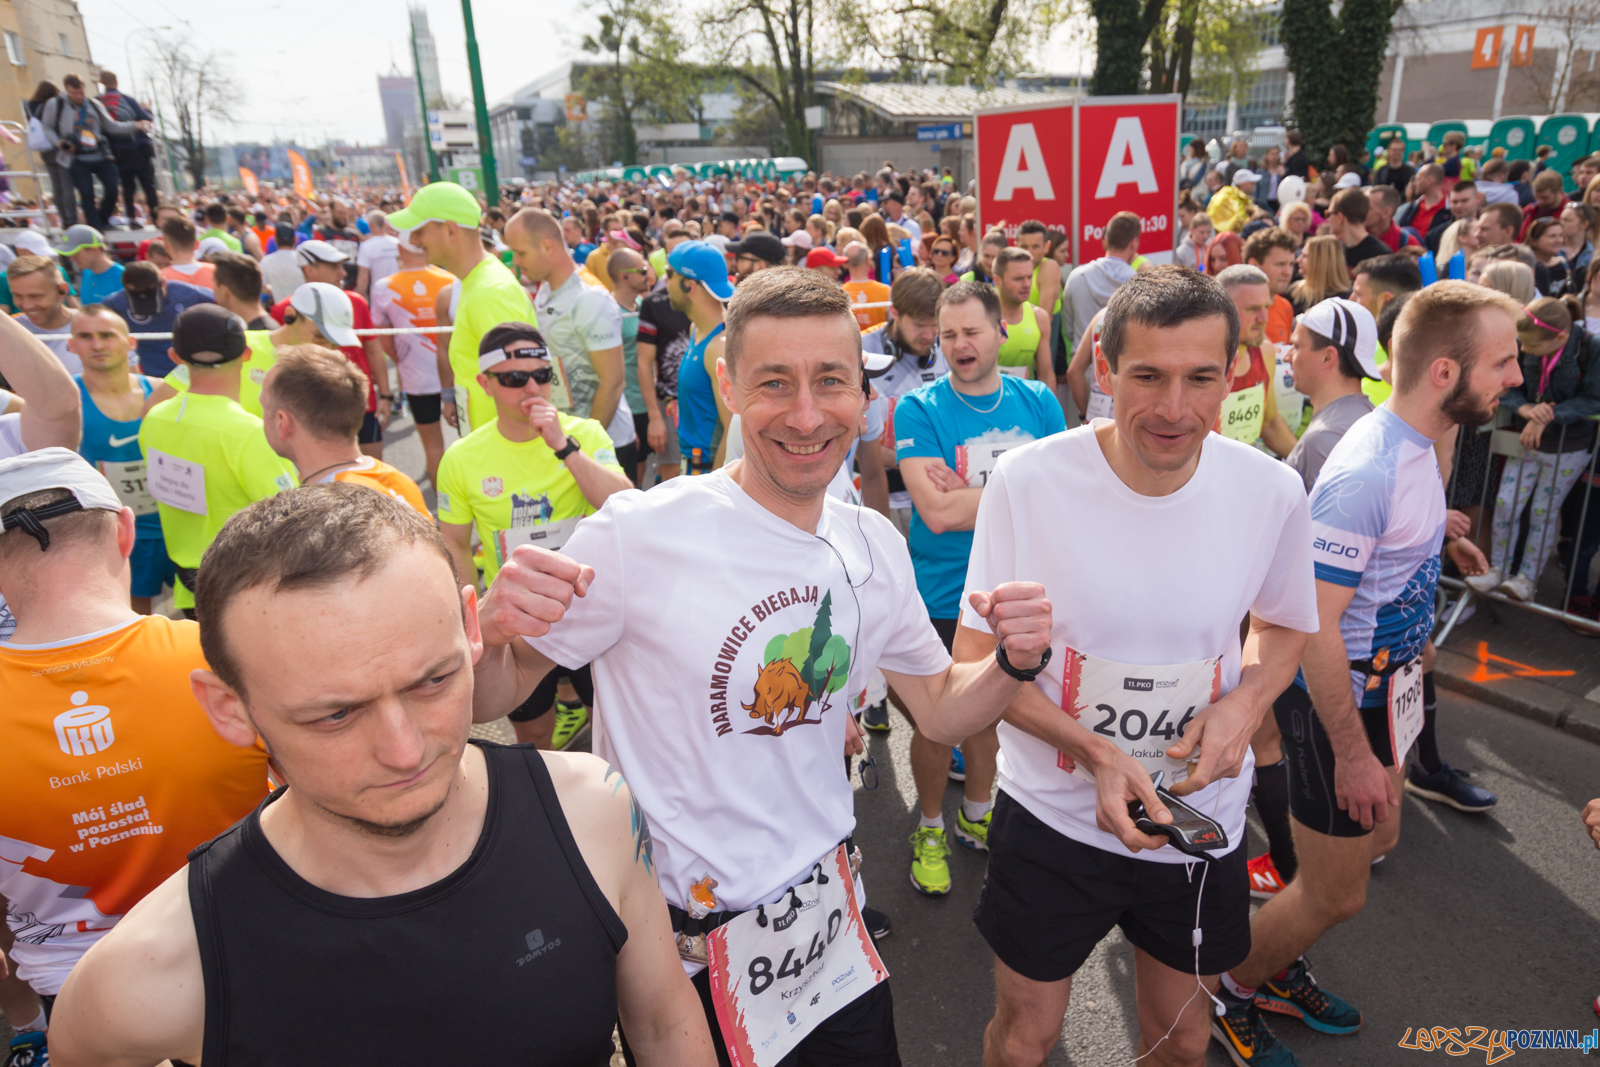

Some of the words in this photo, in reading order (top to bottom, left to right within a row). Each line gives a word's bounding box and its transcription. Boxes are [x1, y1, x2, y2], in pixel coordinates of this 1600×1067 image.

[1481, 33, 1495, 62] 4
[993, 122, 1056, 201] A
[1094, 116, 1160, 200] A
[458, 170, 478, 190] B
[1227, 404, 1260, 425] 8469
[120, 477, 147, 493] 31
[30, 663, 71, 677] Sponsor
[72, 656, 115, 670] tytularny
[709, 615, 756, 738] NARAMOWICE
[751, 585, 818, 623] BIEGAJĄ
[1093, 703, 1197, 741] 2046
[1130, 748, 1164, 758] Jakub
[49, 770, 92, 789] Bank
[96, 757, 143, 779] Polski
[72, 806, 107, 825] Mój
[109, 795, 147, 816] ślad
[76, 808, 150, 840] pozostał
[69, 843, 84, 853] w
[88, 822, 163, 848] Poznaniu
[1252, 871, 1279, 891] N
[515, 937, 562, 967] DOMYOS
[747, 908, 842, 996] 8440
[781, 962, 825, 1000] Krzysztof
